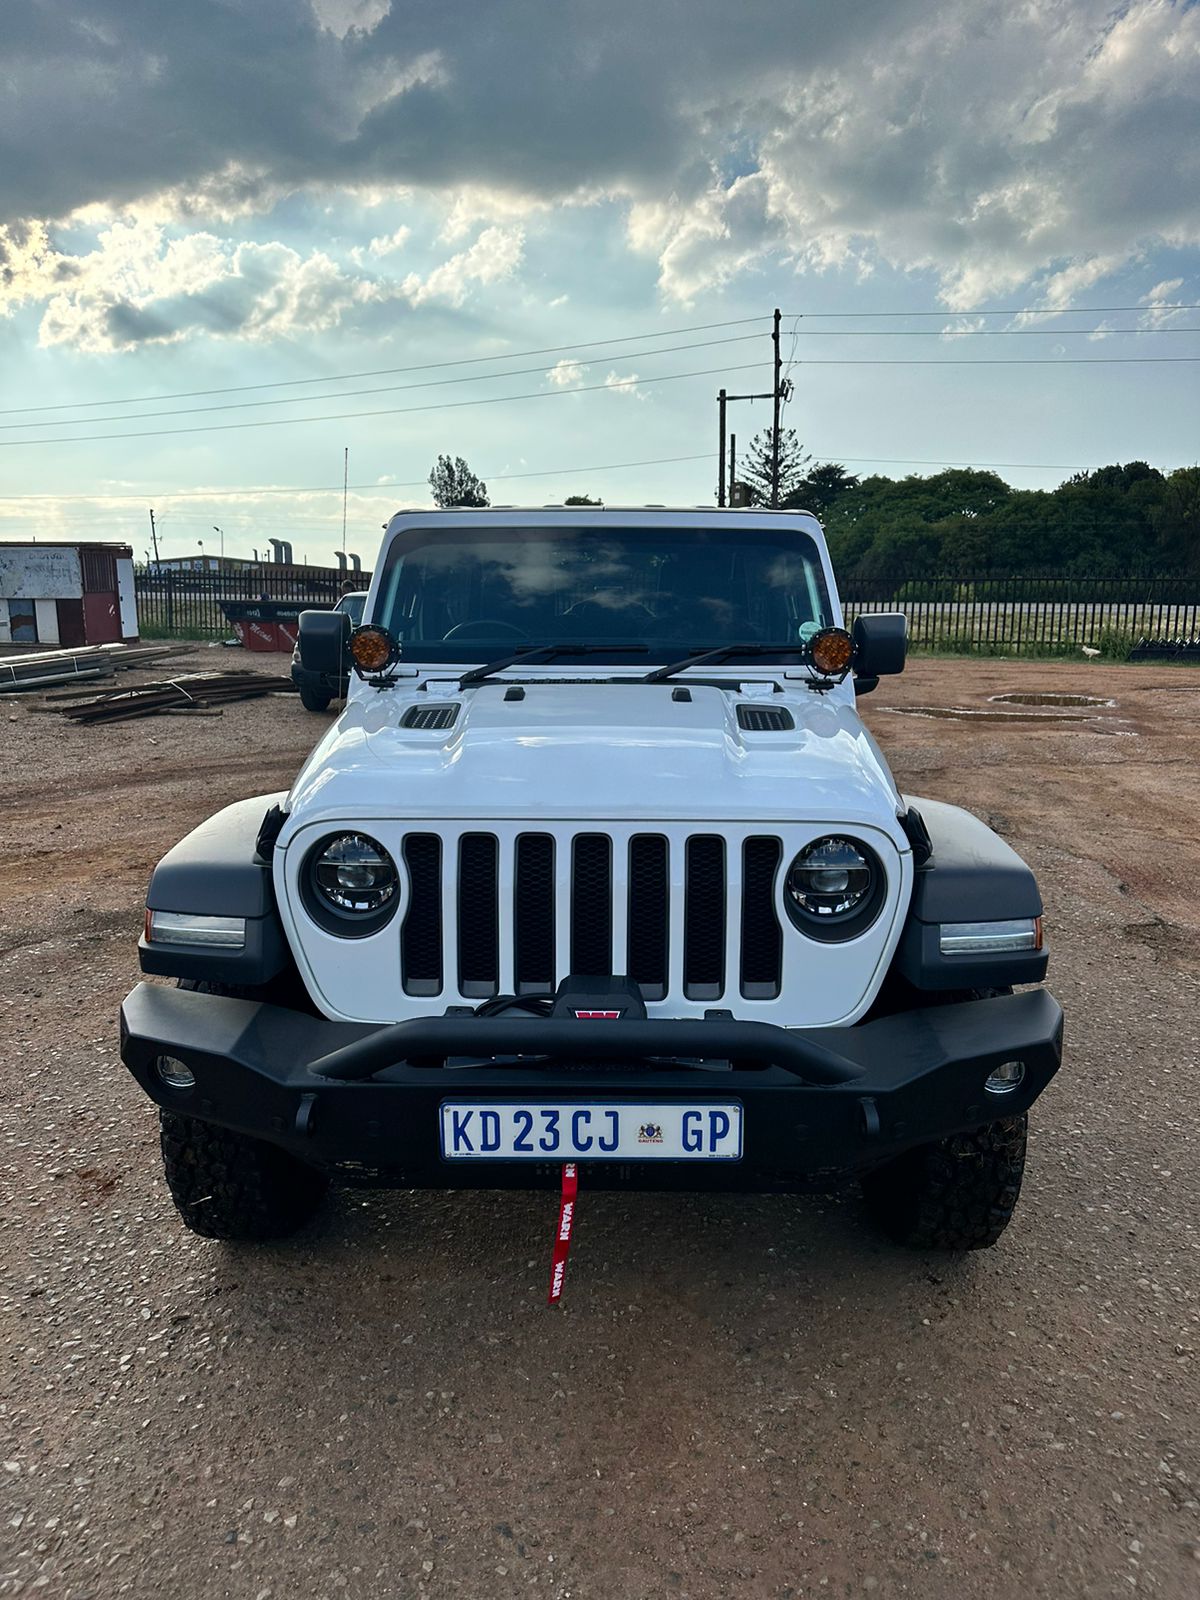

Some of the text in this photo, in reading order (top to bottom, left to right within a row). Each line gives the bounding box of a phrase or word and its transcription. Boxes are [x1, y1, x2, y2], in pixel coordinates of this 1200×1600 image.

[452, 1110, 731, 1153] KD 23 CJ GP
[559, 1201, 574, 1241] WARN
[551, 1260, 565, 1298] WARN
